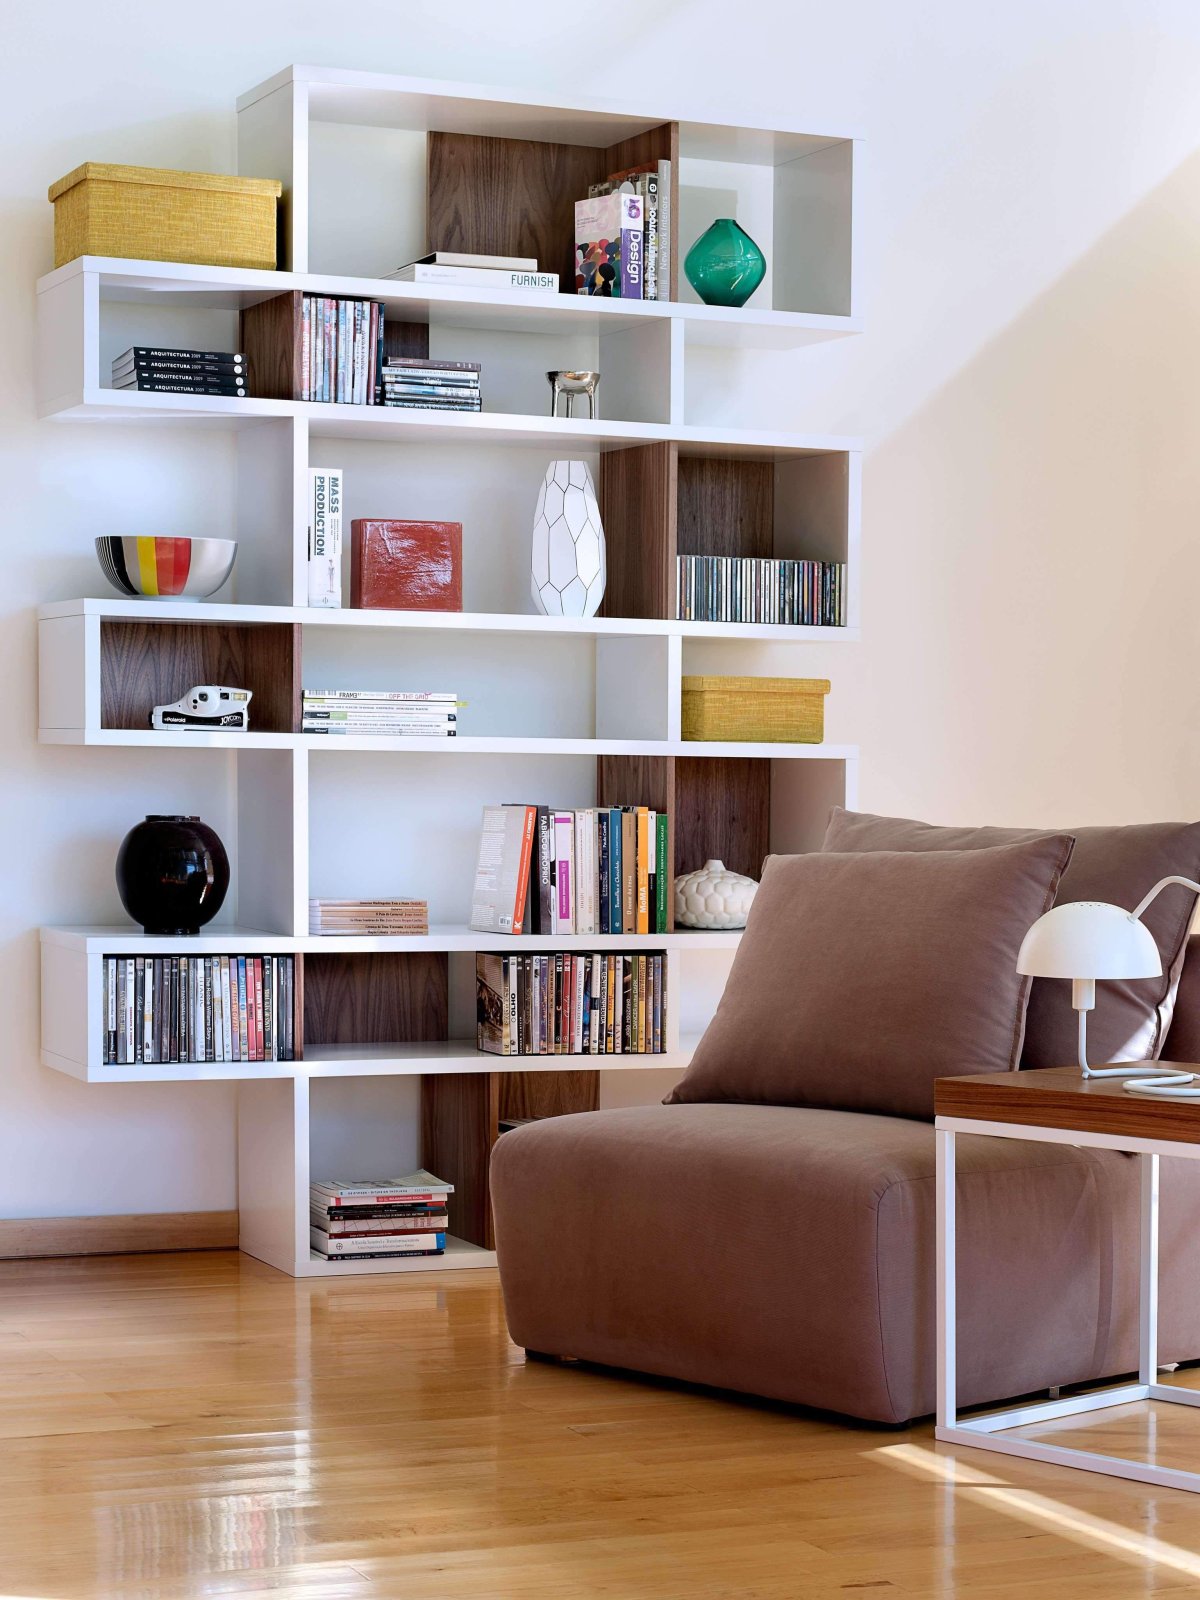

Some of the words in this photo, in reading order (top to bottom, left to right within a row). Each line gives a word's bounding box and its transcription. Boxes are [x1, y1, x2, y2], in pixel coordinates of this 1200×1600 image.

[659, 195, 668, 230] Interiors
[627, 231, 641, 284] Design
[660, 232, 668, 250] York
[660, 251, 668, 270] New
[511, 274, 554, 287] FURNISH
[331, 477, 339, 513] MASS
[317, 476, 325, 556] PRODUCTION
